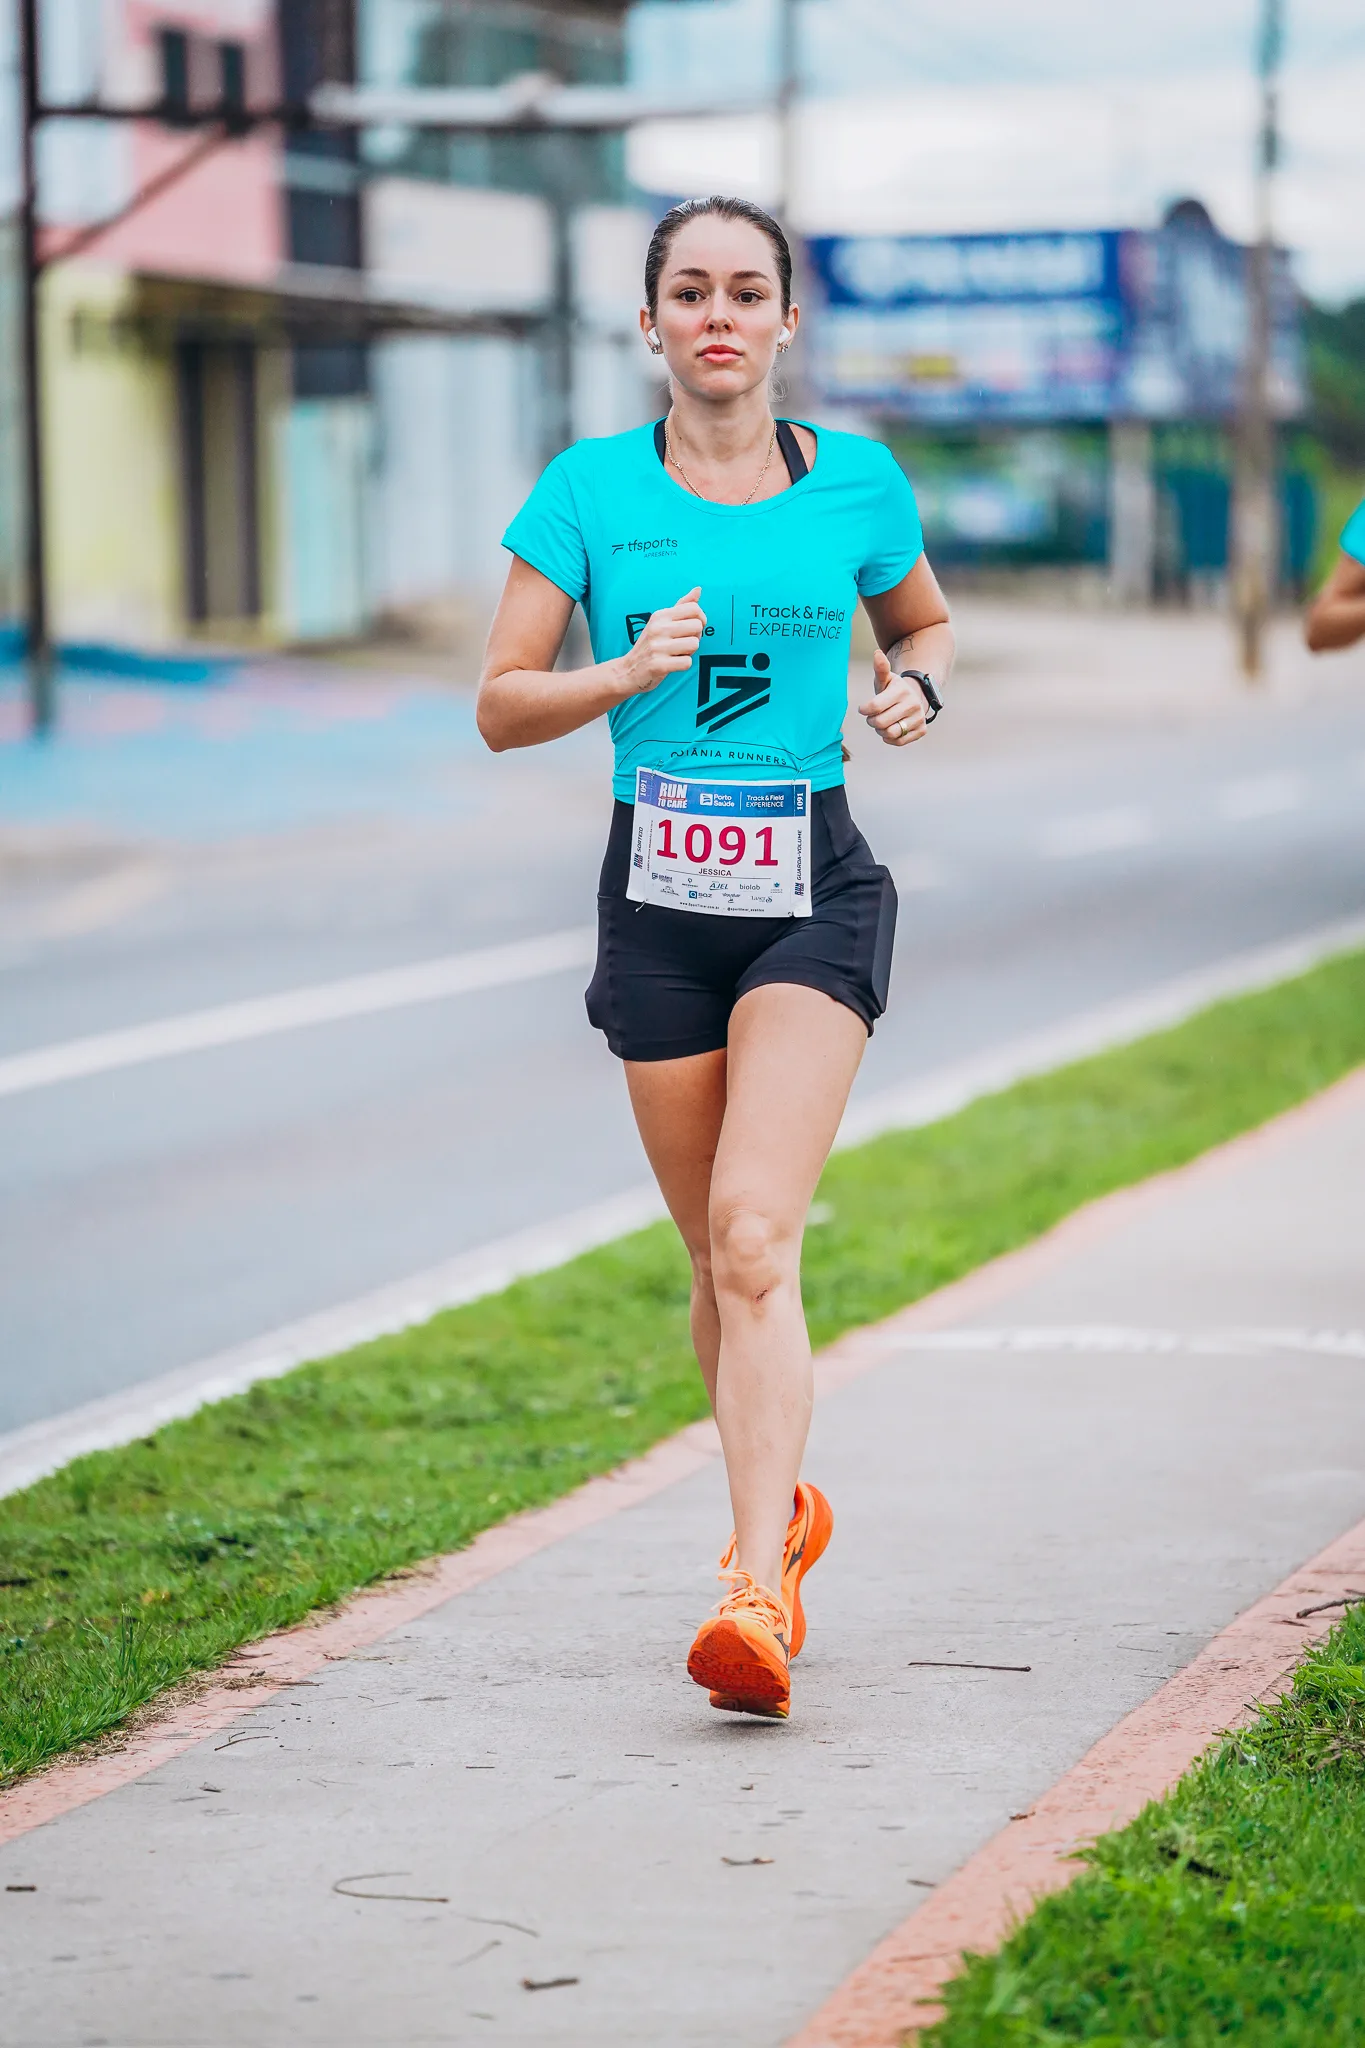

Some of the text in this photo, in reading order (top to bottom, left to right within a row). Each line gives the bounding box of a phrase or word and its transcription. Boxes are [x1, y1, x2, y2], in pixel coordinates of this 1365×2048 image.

[627, 537, 678, 552] tfsports
[751, 604, 800, 619] Track
[817, 606, 845, 622] Field
[749, 622, 842, 640] EXPERIENCE
[728, 751, 787, 766] RUNNERS
[639, 779, 648, 797] 1091
[659, 782, 688, 799] RUN
[658, 797, 688, 809] TO CARE
[713, 793, 733, 801] Porto
[713, 800, 735, 808] Saúde
[796, 793, 804, 811] 1091
[656, 819, 779, 867] 1091
[698, 867, 732, 877] JESSICA
[739, 883, 761, 891] biolab
